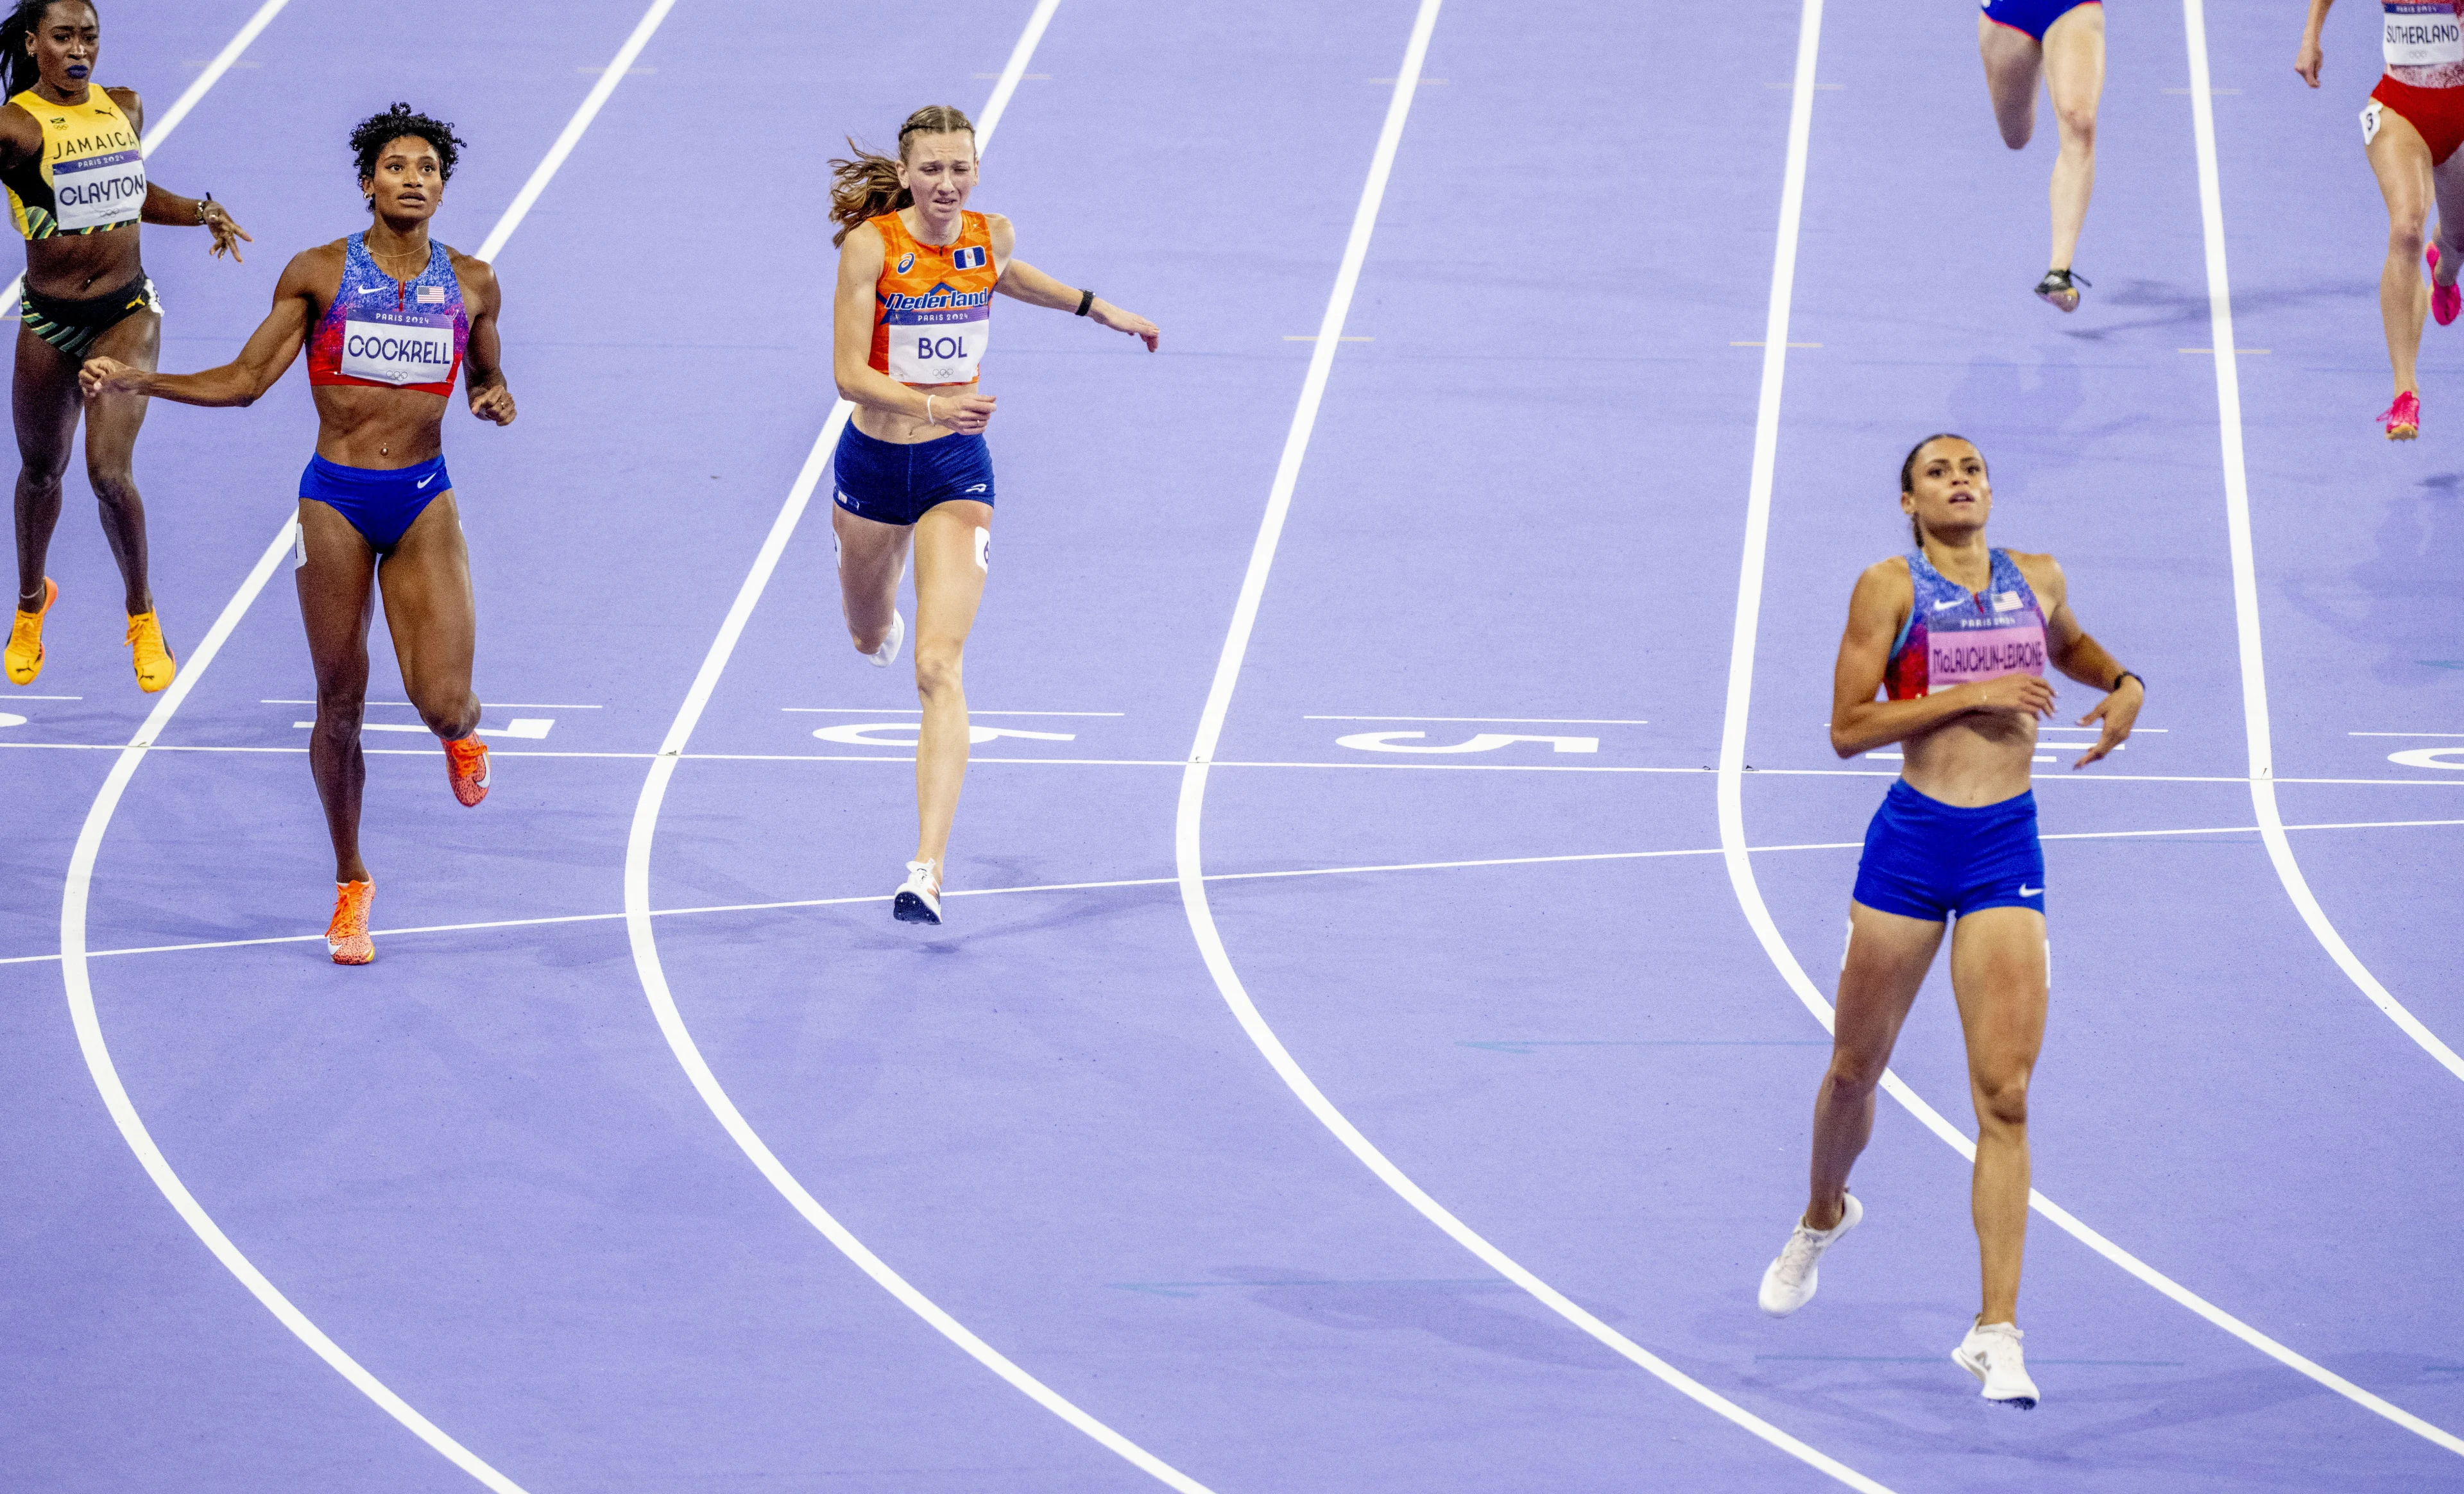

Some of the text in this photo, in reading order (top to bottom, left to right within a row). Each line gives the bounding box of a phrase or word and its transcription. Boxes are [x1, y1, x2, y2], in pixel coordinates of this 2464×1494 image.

[2386, 24, 2460, 44] SUTHERLAND
[2366, 113, 2374, 131] 3
[53, 132, 137, 160] JAMAICA
[78, 154, 124, 168] PARIS 2024
[60, 174, 145, 206] CLAYTON
[376, 313, 430, 324] PARIS 2024
[348, 334, 451, 365] COCKRELL
[918, 336, 968, 359] BOL
[1961, 618, 1992, 628] PARIS
[812, 723, 1076, 746] 6
[1335, 731, 1600, 753] 5
